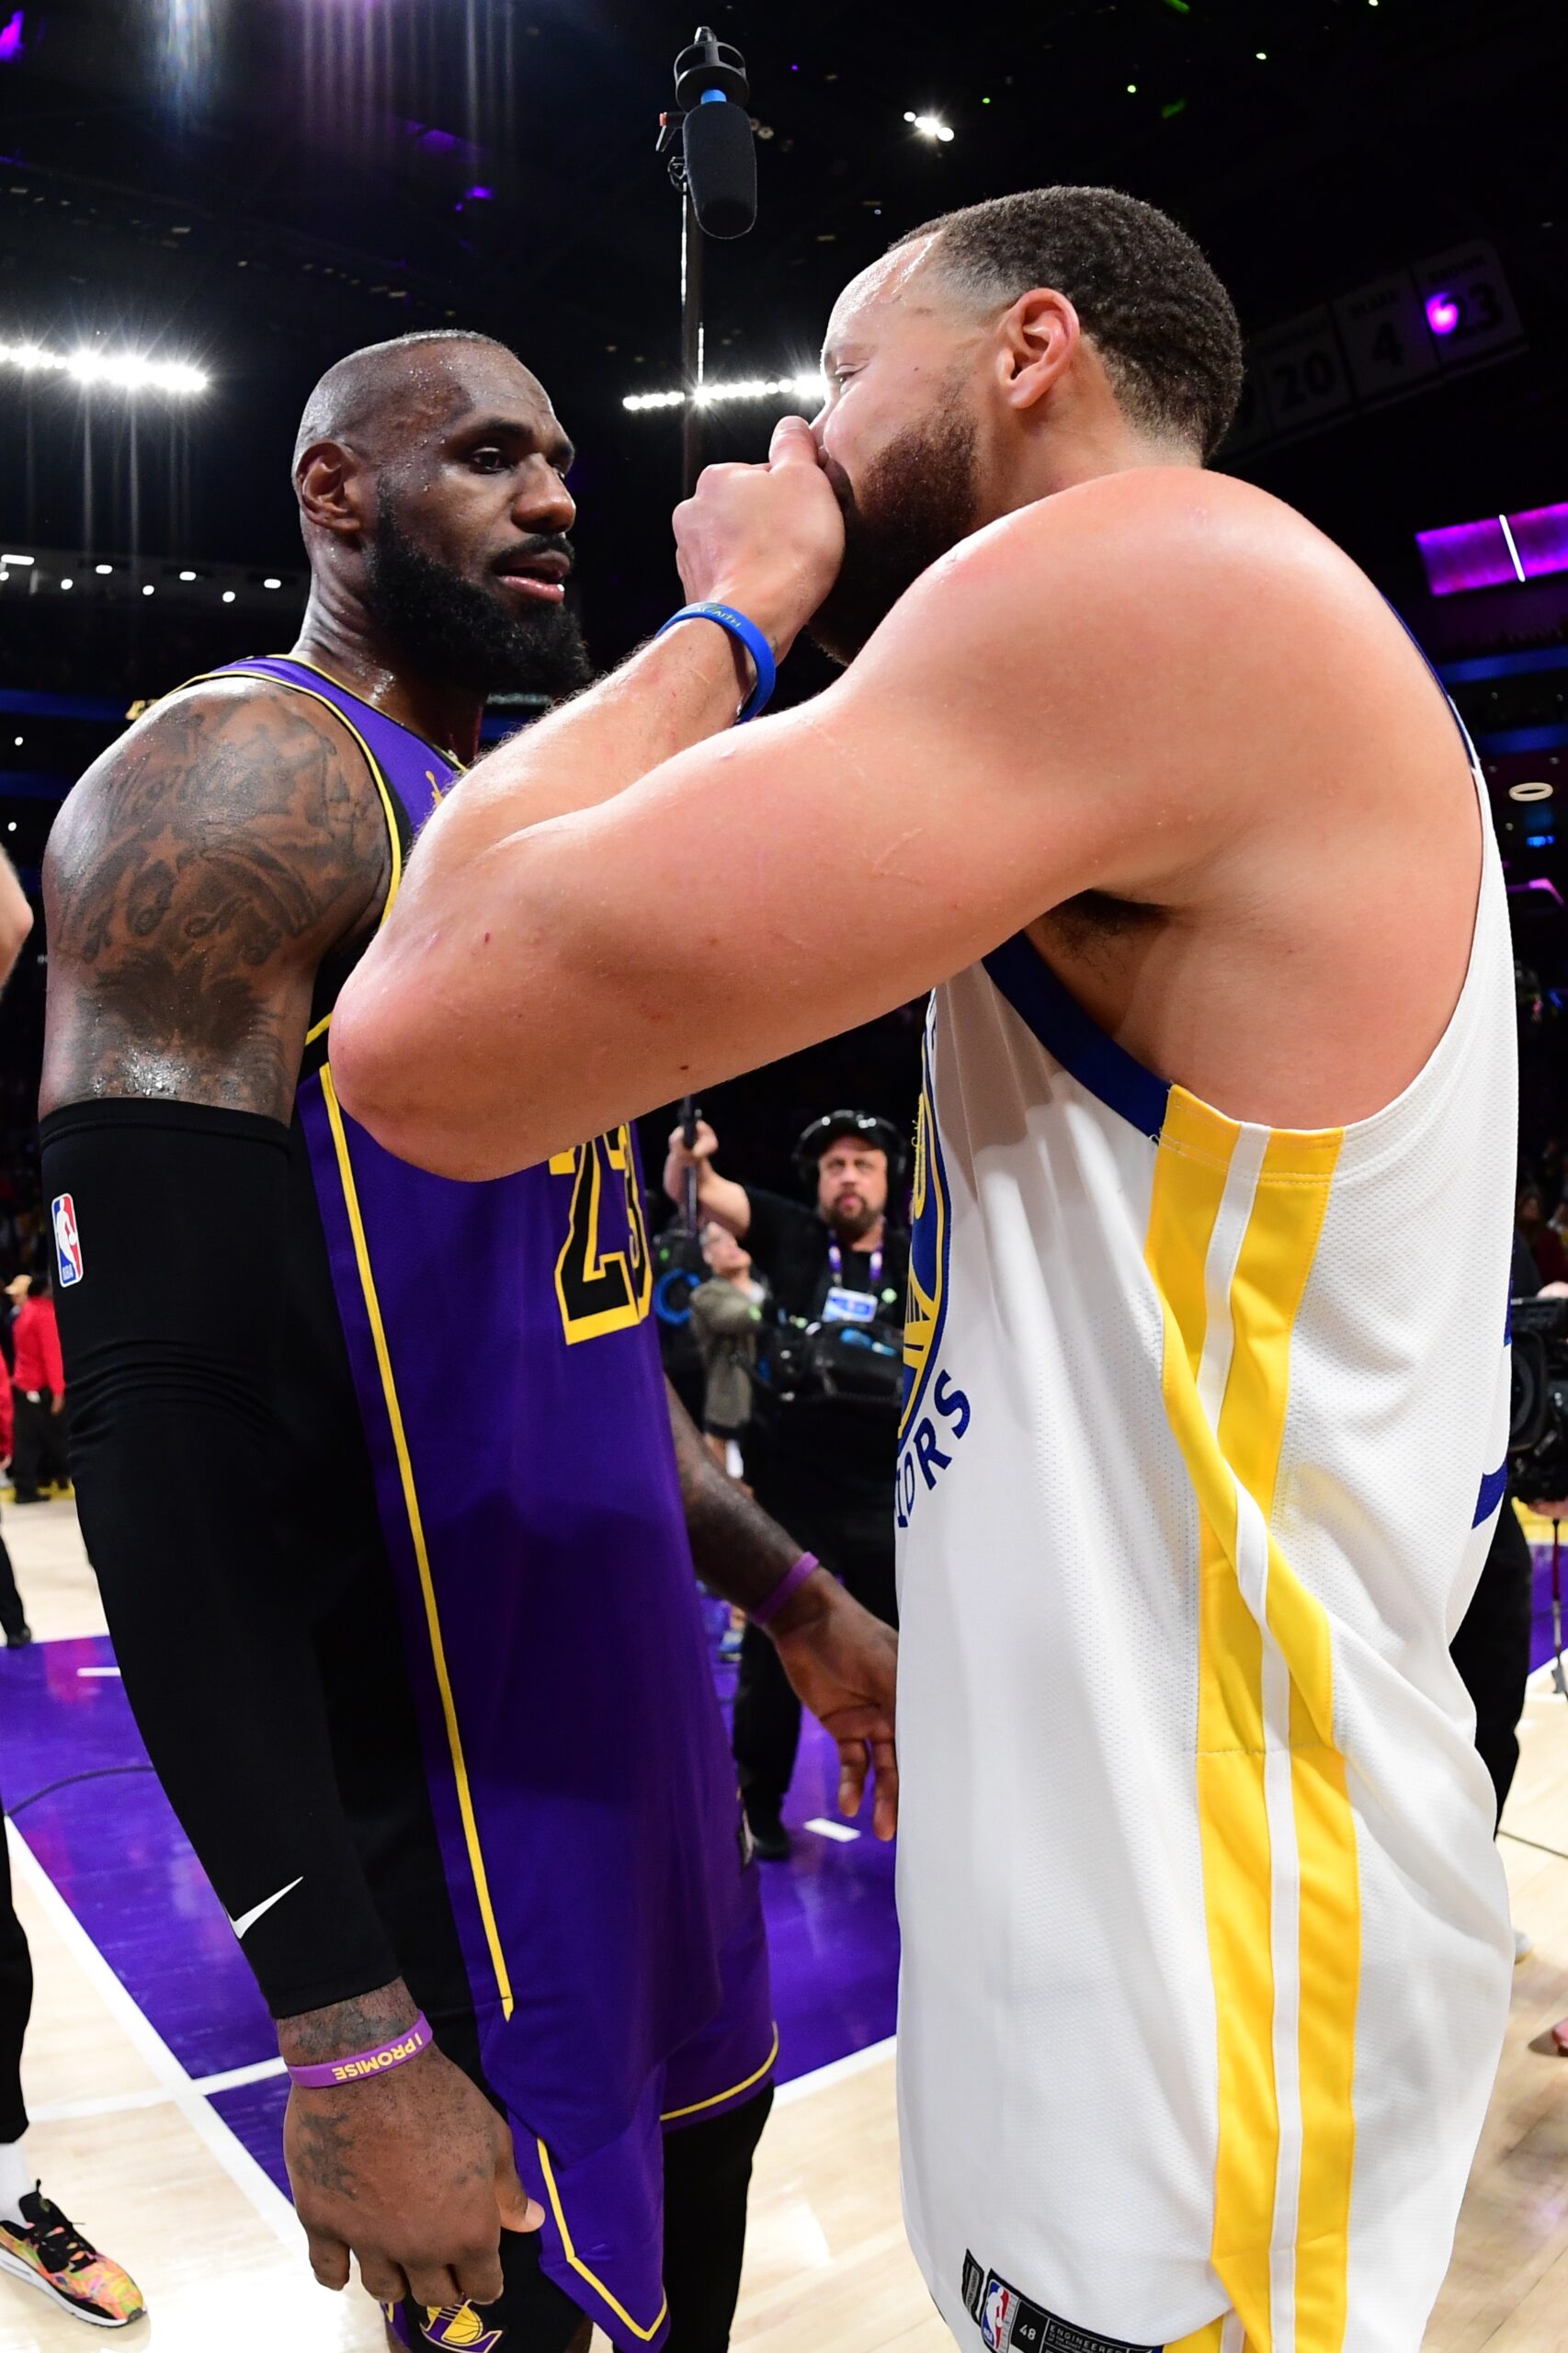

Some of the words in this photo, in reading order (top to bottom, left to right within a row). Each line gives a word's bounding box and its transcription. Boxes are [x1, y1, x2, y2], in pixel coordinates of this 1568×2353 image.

[1372, 321, 1403, 367] 4
[1273, 350, 1335, 408] 20
[332, 2038, 416, 2081] PROMISE
[415, 2032, 423, 2046] I
[1018, 2325, 1037, 2341] 48
